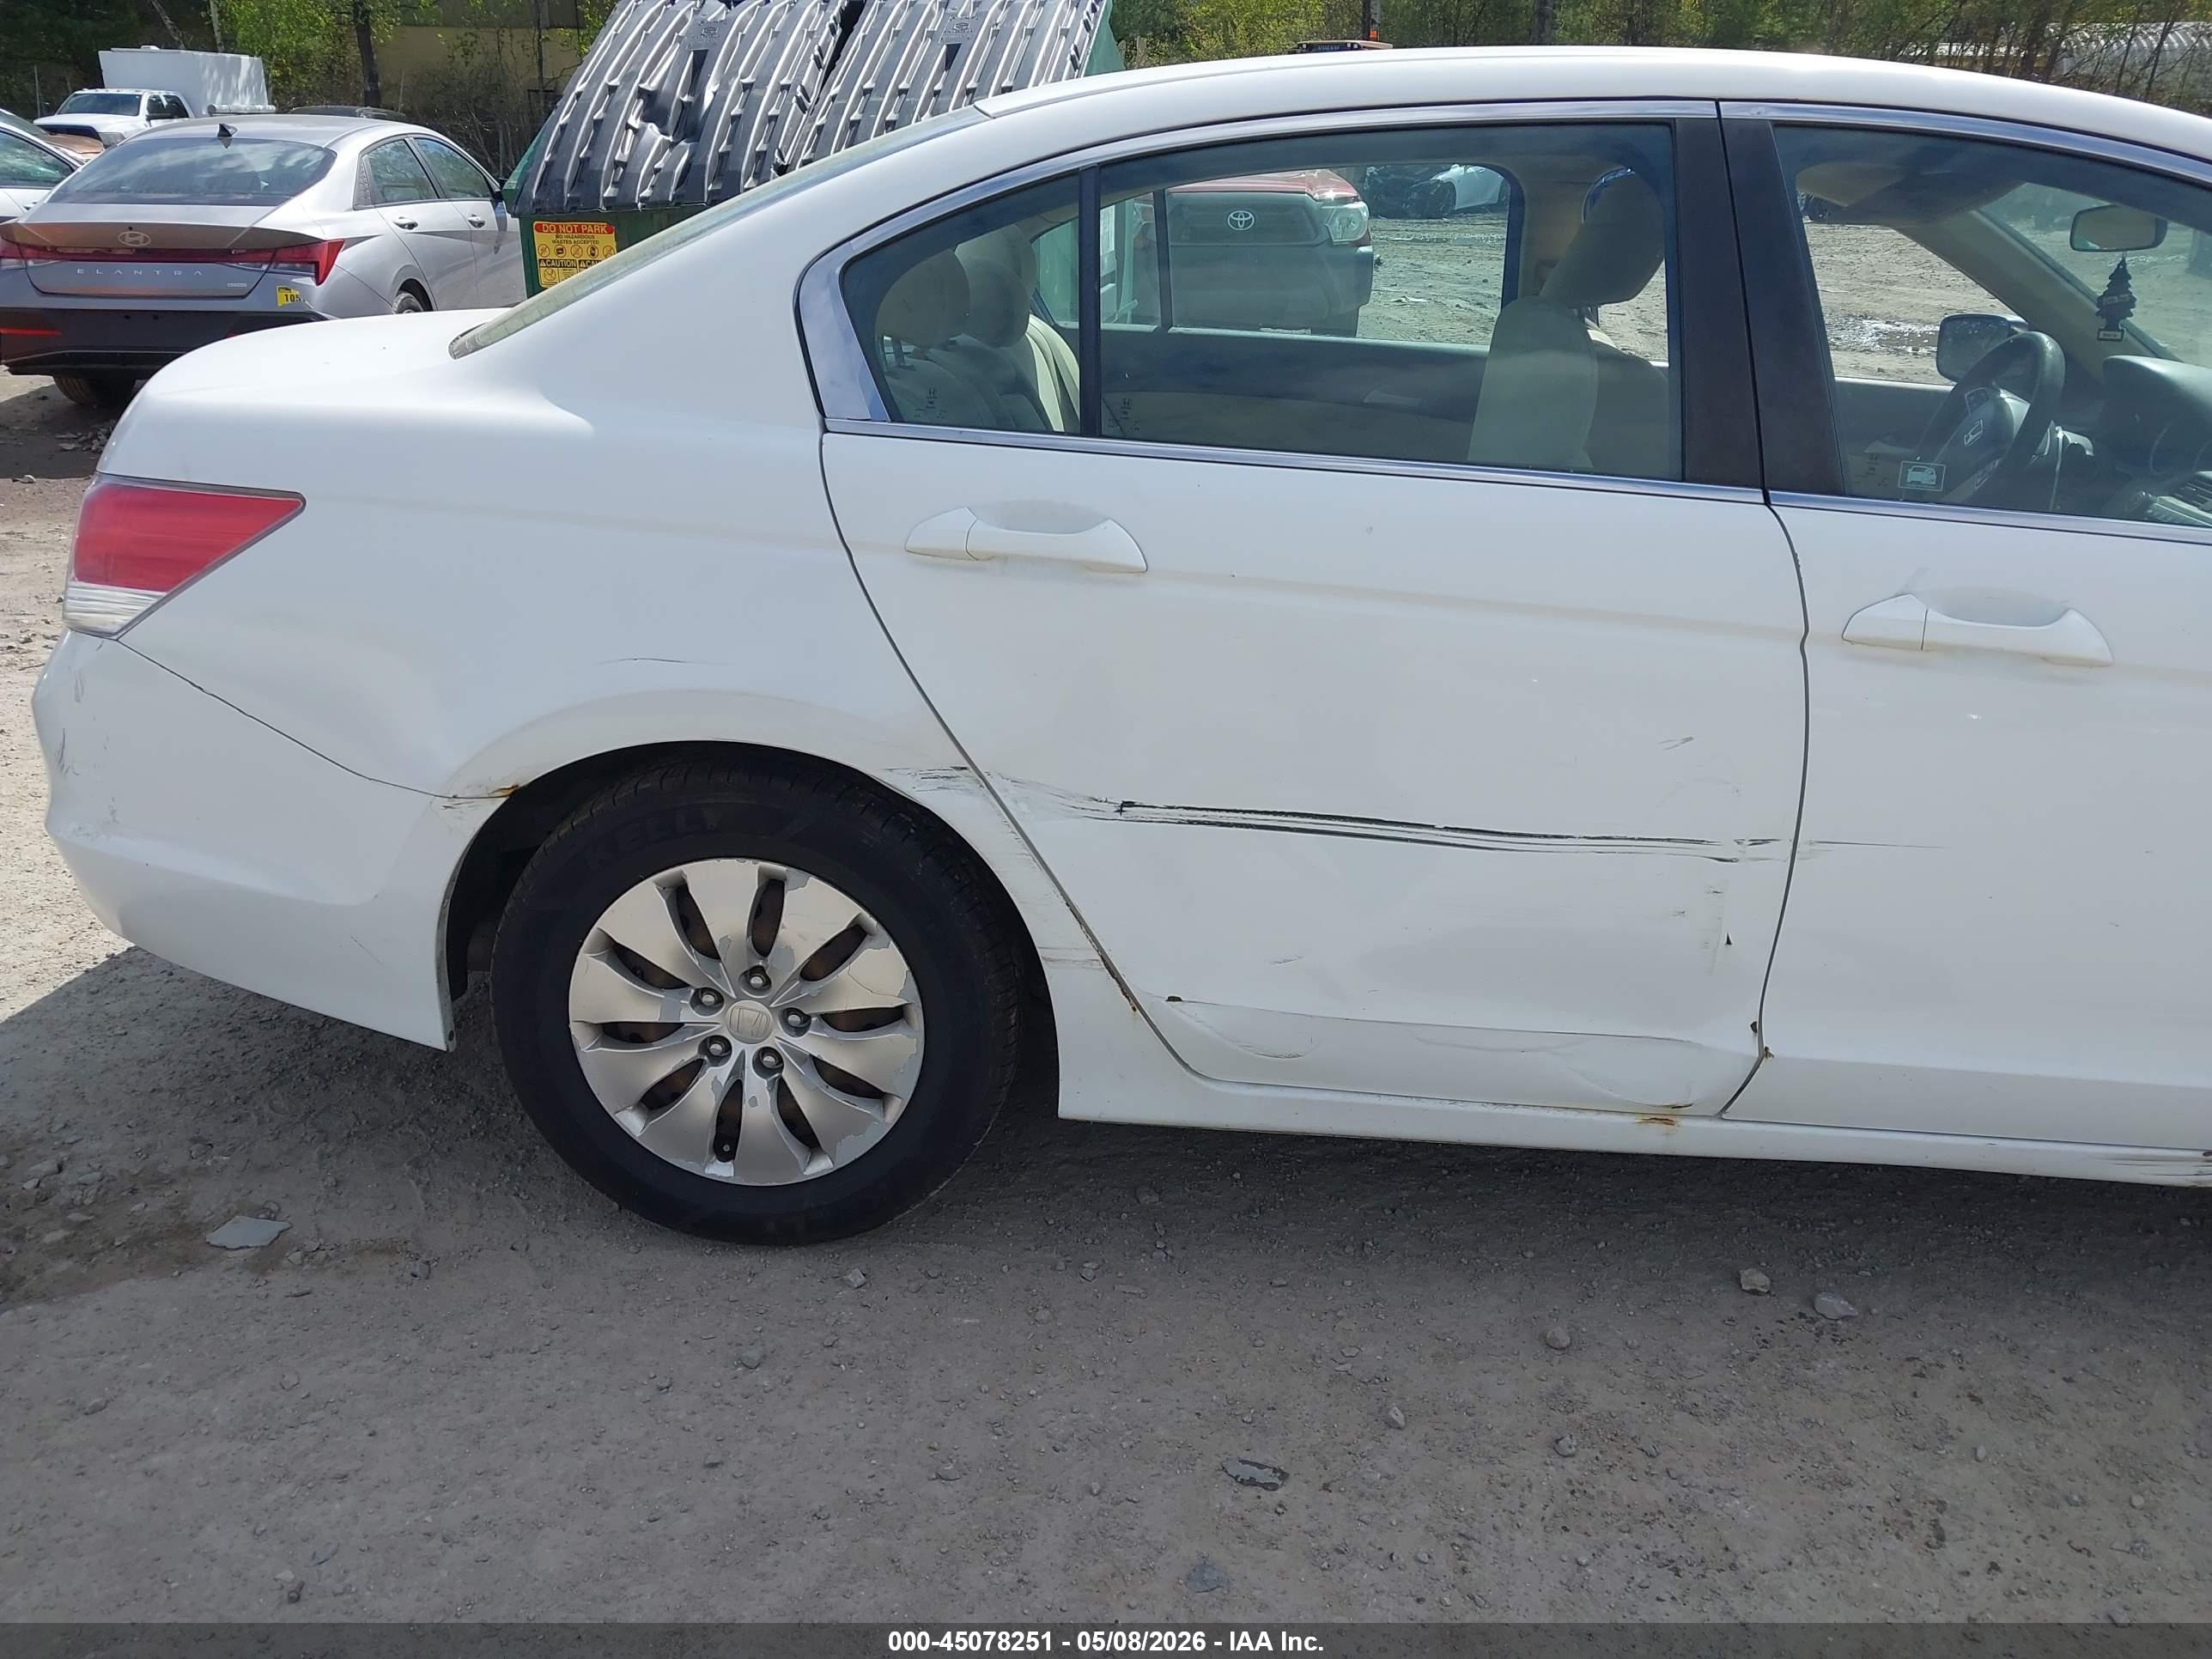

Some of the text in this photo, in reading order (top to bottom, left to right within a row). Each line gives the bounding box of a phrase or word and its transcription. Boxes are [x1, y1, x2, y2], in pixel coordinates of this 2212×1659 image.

[542, 224, 608, 234] DO NOT PARK
[584, 805, 725, 871] KELLY
